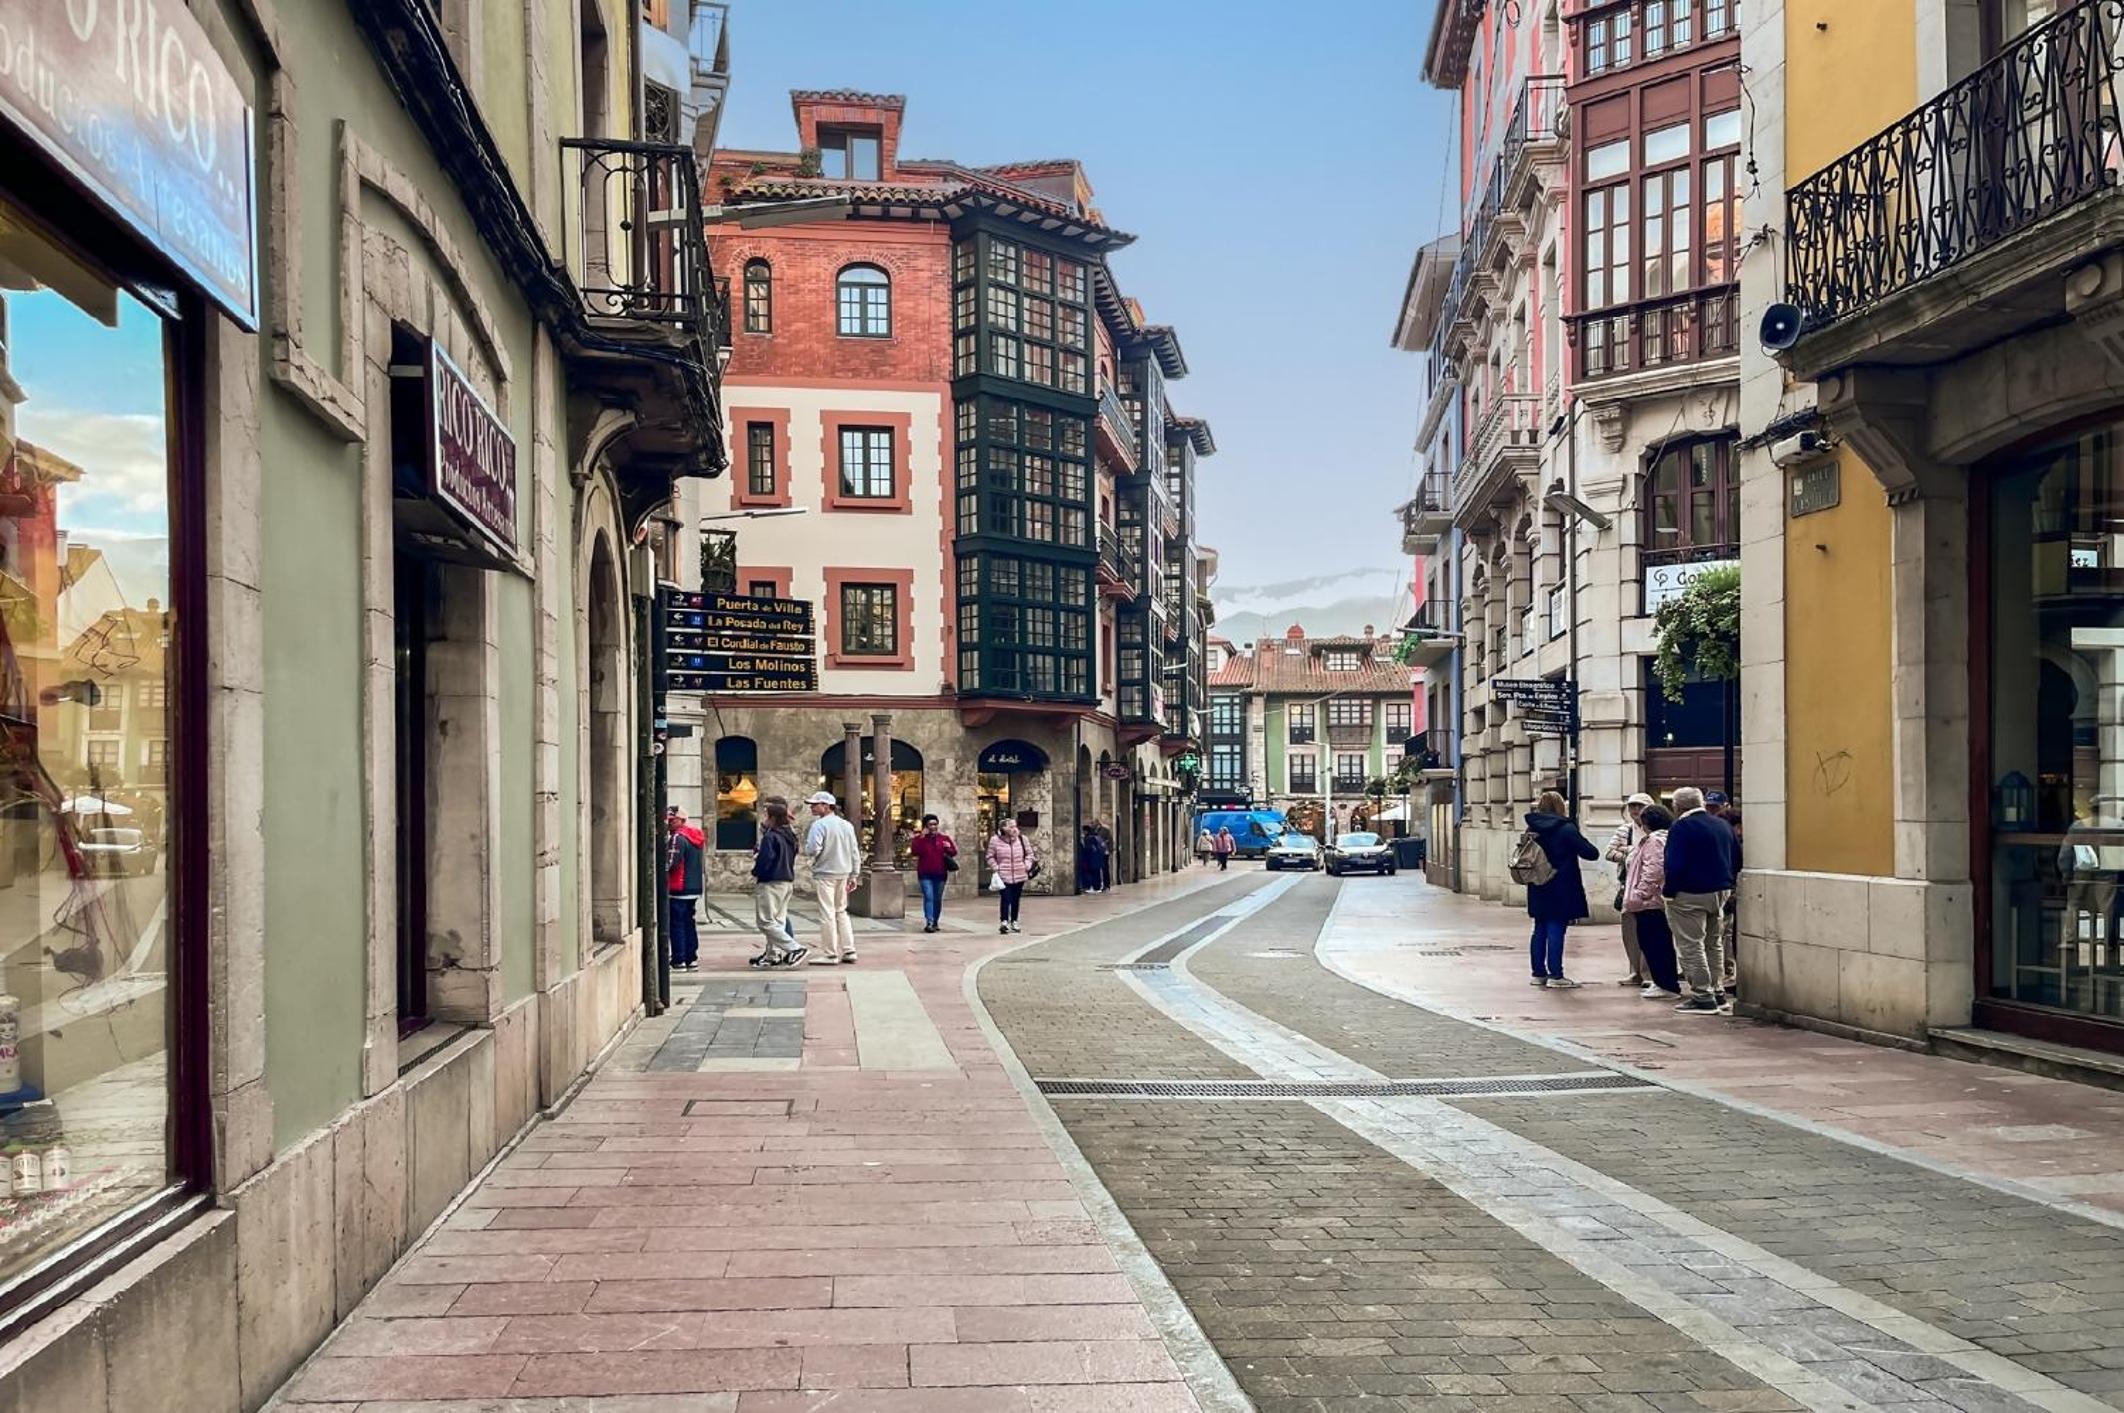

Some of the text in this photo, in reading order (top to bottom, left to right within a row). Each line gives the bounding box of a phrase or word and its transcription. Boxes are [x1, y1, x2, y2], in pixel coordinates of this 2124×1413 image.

[436, 360, 473, 456] RICO
[439, 443, 482, 514] Productos
[717, 597, 759, 611] Puerta
[774, 602, 803, 615] Villa
[707, 615, 723, 627] La
[725, 616, 767, 630] Posada
[782, 621, 804, 634] Rey
[707, 637, 719, 648] El
[721, 638, 759, 650] Cordial
[770, 639, 806, 652] Fausto
[728, 657, 806, 673] Los Molinos
[726, 676, 750, 689] Las
[754, 677, 807, 690] Fuentes
